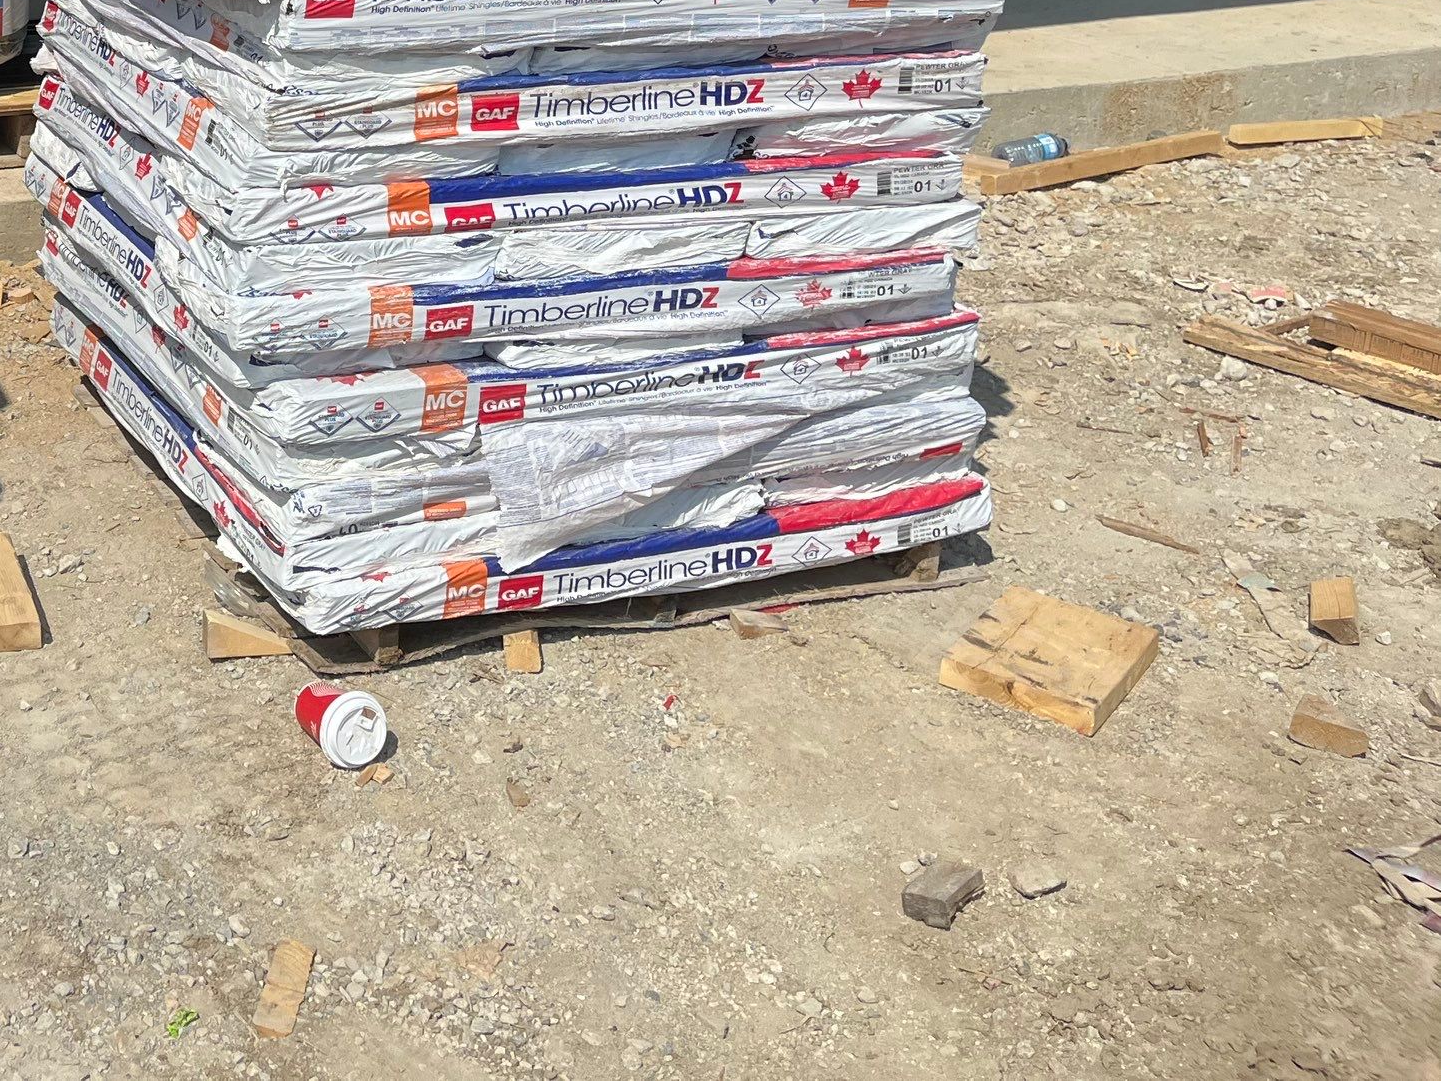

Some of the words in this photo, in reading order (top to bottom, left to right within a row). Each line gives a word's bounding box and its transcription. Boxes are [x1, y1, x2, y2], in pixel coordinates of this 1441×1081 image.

[371, 5, 390, 14] High
[699, 79, 765, 106] HDZ
[934, 80, 953, 93] 01
[40, 88, 56, 104] GAF
[417, 101, 457, 118] MC
[475, 107, 515, 120] GAF
[535, 120, 554, 128] High
[718, 108, 736, 117] High
[97, 117, 121, 148] HDZ
[677, 182, 744, 207] HDZ
[914, 181, 933, 193] 01
[389, 210, 429, 226] MC
[126, 255, 152, 289] HDZ
[877, 284, 894, 296] 01
[653, 287, 719, 312] HDZ
[373, 313, 412, 330] MC
[429, 318, 469, 333] GAF
[911, 347, 928, 360] 01
[95, 359, 110, 378] GAF
[425, 390, 466, 411] MC
[483, 398, 522, 413] GAF
[162, 428, 189, 474] HDZ
[932, 525, 950, 538] 01
[711, 544, 773, 573] HDZ
[447, 584, 486, 600] MC
[501, 587, 539, 602] GAF
